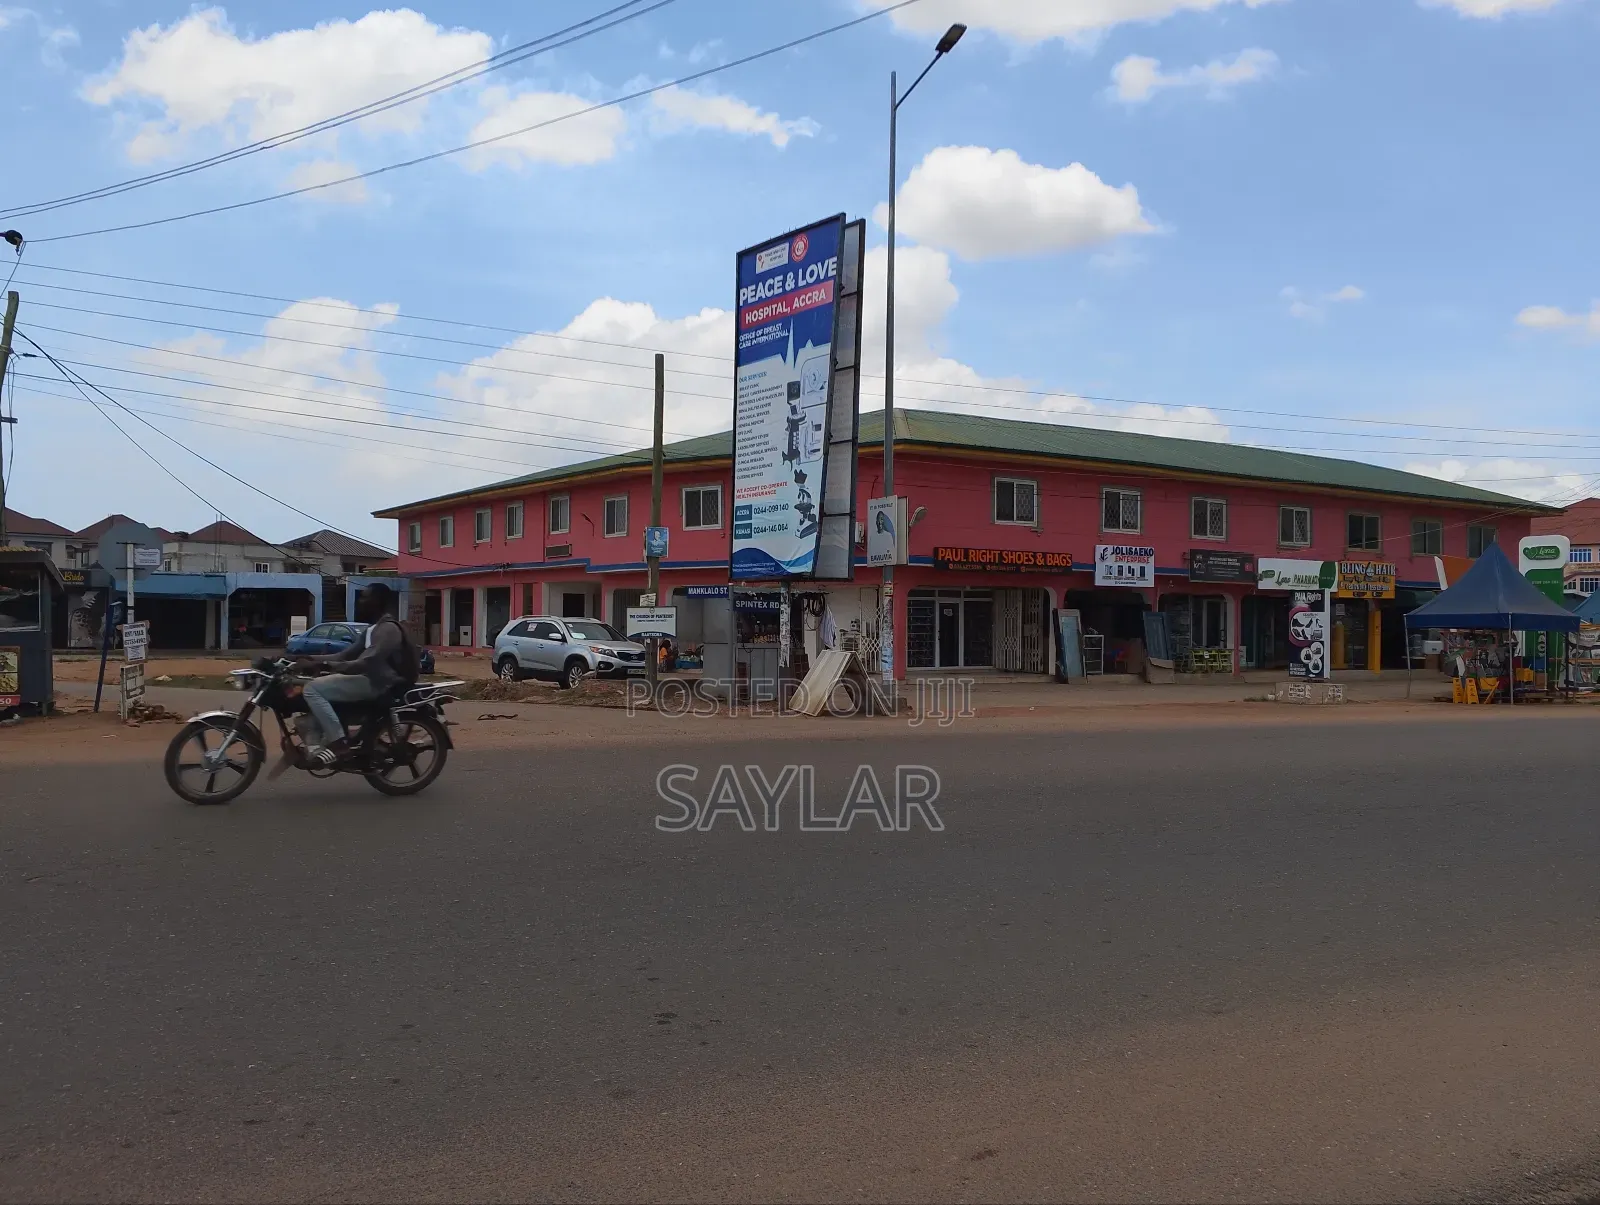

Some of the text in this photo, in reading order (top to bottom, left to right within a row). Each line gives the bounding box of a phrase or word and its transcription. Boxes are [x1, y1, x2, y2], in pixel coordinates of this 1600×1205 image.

[740, 256, 837, 306] PEACE & LOVE
[745, 288, 826, 324] HOSPITAL, ACCRA
[938, 547, 1072, 567] PAUL RIGHT SHOES & BAGS
[1115, 555, 1150, 563] ENTERPRISE
[688, 587, 728, 595] MANKLALO ST.
[735, 600, 767, 609] SPINTEX
